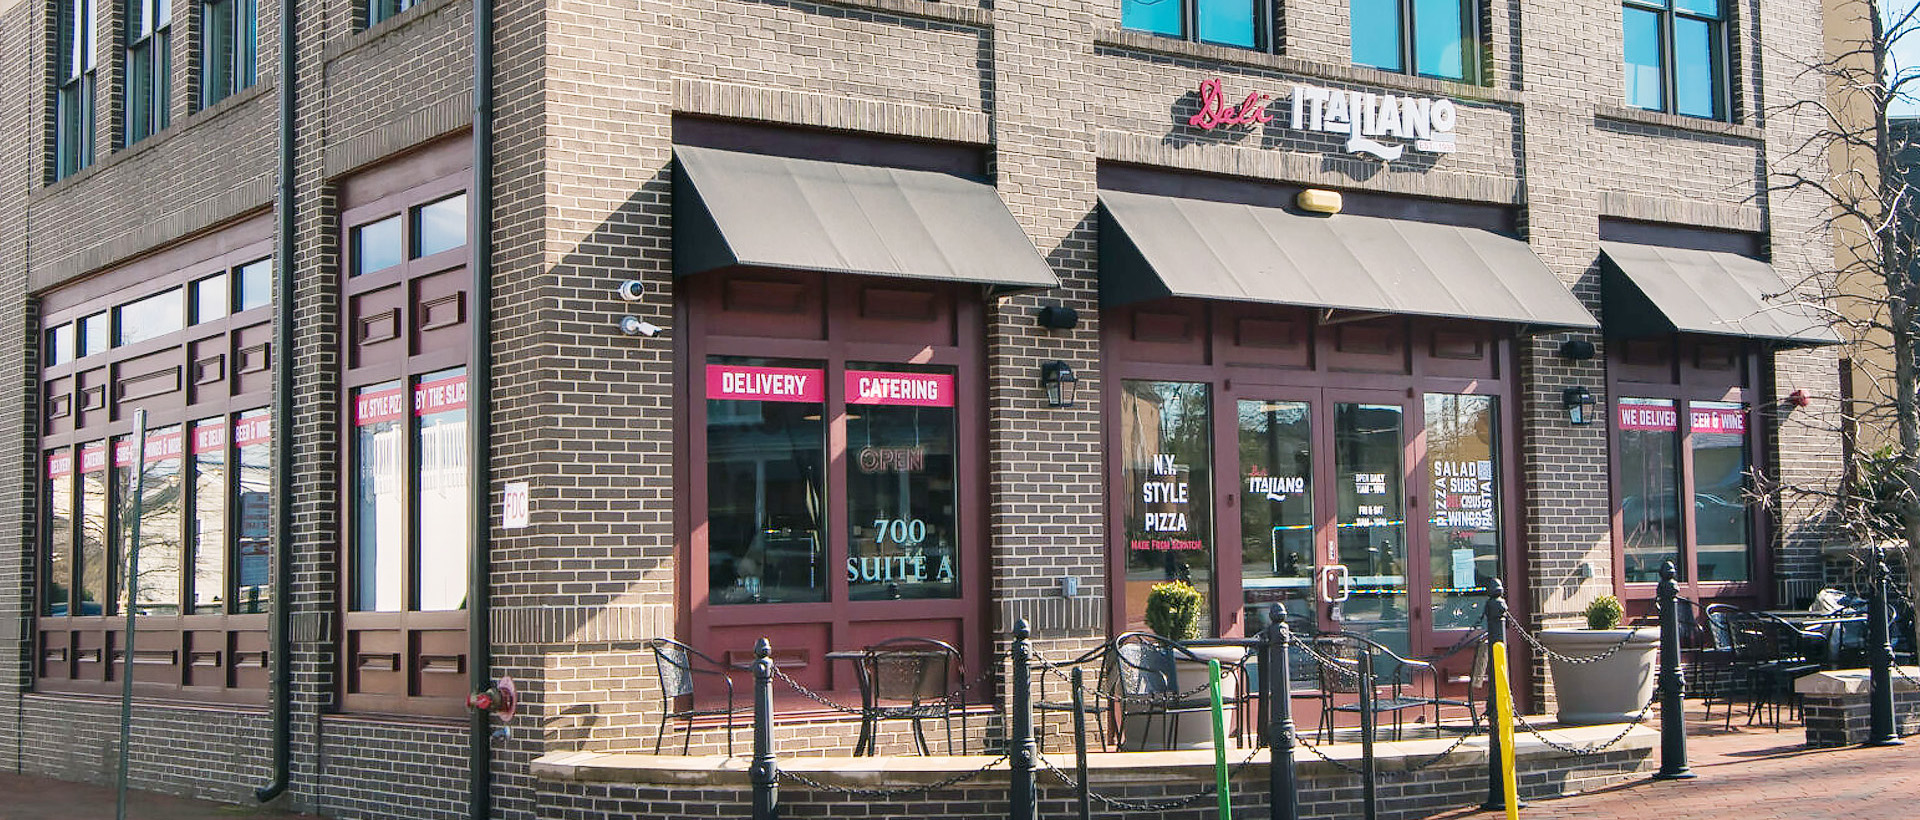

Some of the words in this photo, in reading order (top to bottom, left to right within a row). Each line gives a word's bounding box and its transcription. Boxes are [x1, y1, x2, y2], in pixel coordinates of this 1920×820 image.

[1189, 79, 1274, 130] Deli
[1291, 86, 1457, 160] ITALIANO
[722, 372, 806, 396] DELIVERY
[859, 377, 938, 400] CATERING
[369, 396, 388, 417] STYLE
[389, 393, 402, 415] PIZZ
[415, 390, 426, 411] BY
[428, 386, 444, 409] THE
[1621, 408, 1636, 425] WE
[1640, 409, 1677, 427] DELIVER
[1712, 411, 1719, 429] &
[1721, 413, 1744, 430] WINE
[860, 446, 924, 472] OPEN
[1153, 454, 1177, 475] N.Y.
[1434, 460, 1476, 477] SALAD
[1143, 482, 1187, 503] STYLE
[1249, 476, 1304, 501] ITALIANO
[1450, 477, 1478, 493] SUBS
[505, 492, 526, 519] FDC
[1435, 477, 1448, 527] PIZZA
[1481, 482, 1493, 527] PASTA
[1145, 512, 1187, 532] PIZZA
[1448, 511, 1482, 527] WINGS
[874, 519, 926, 544] 700
[847, 556, 928, 582] SUITE
[937, 555, 956, 580] A
